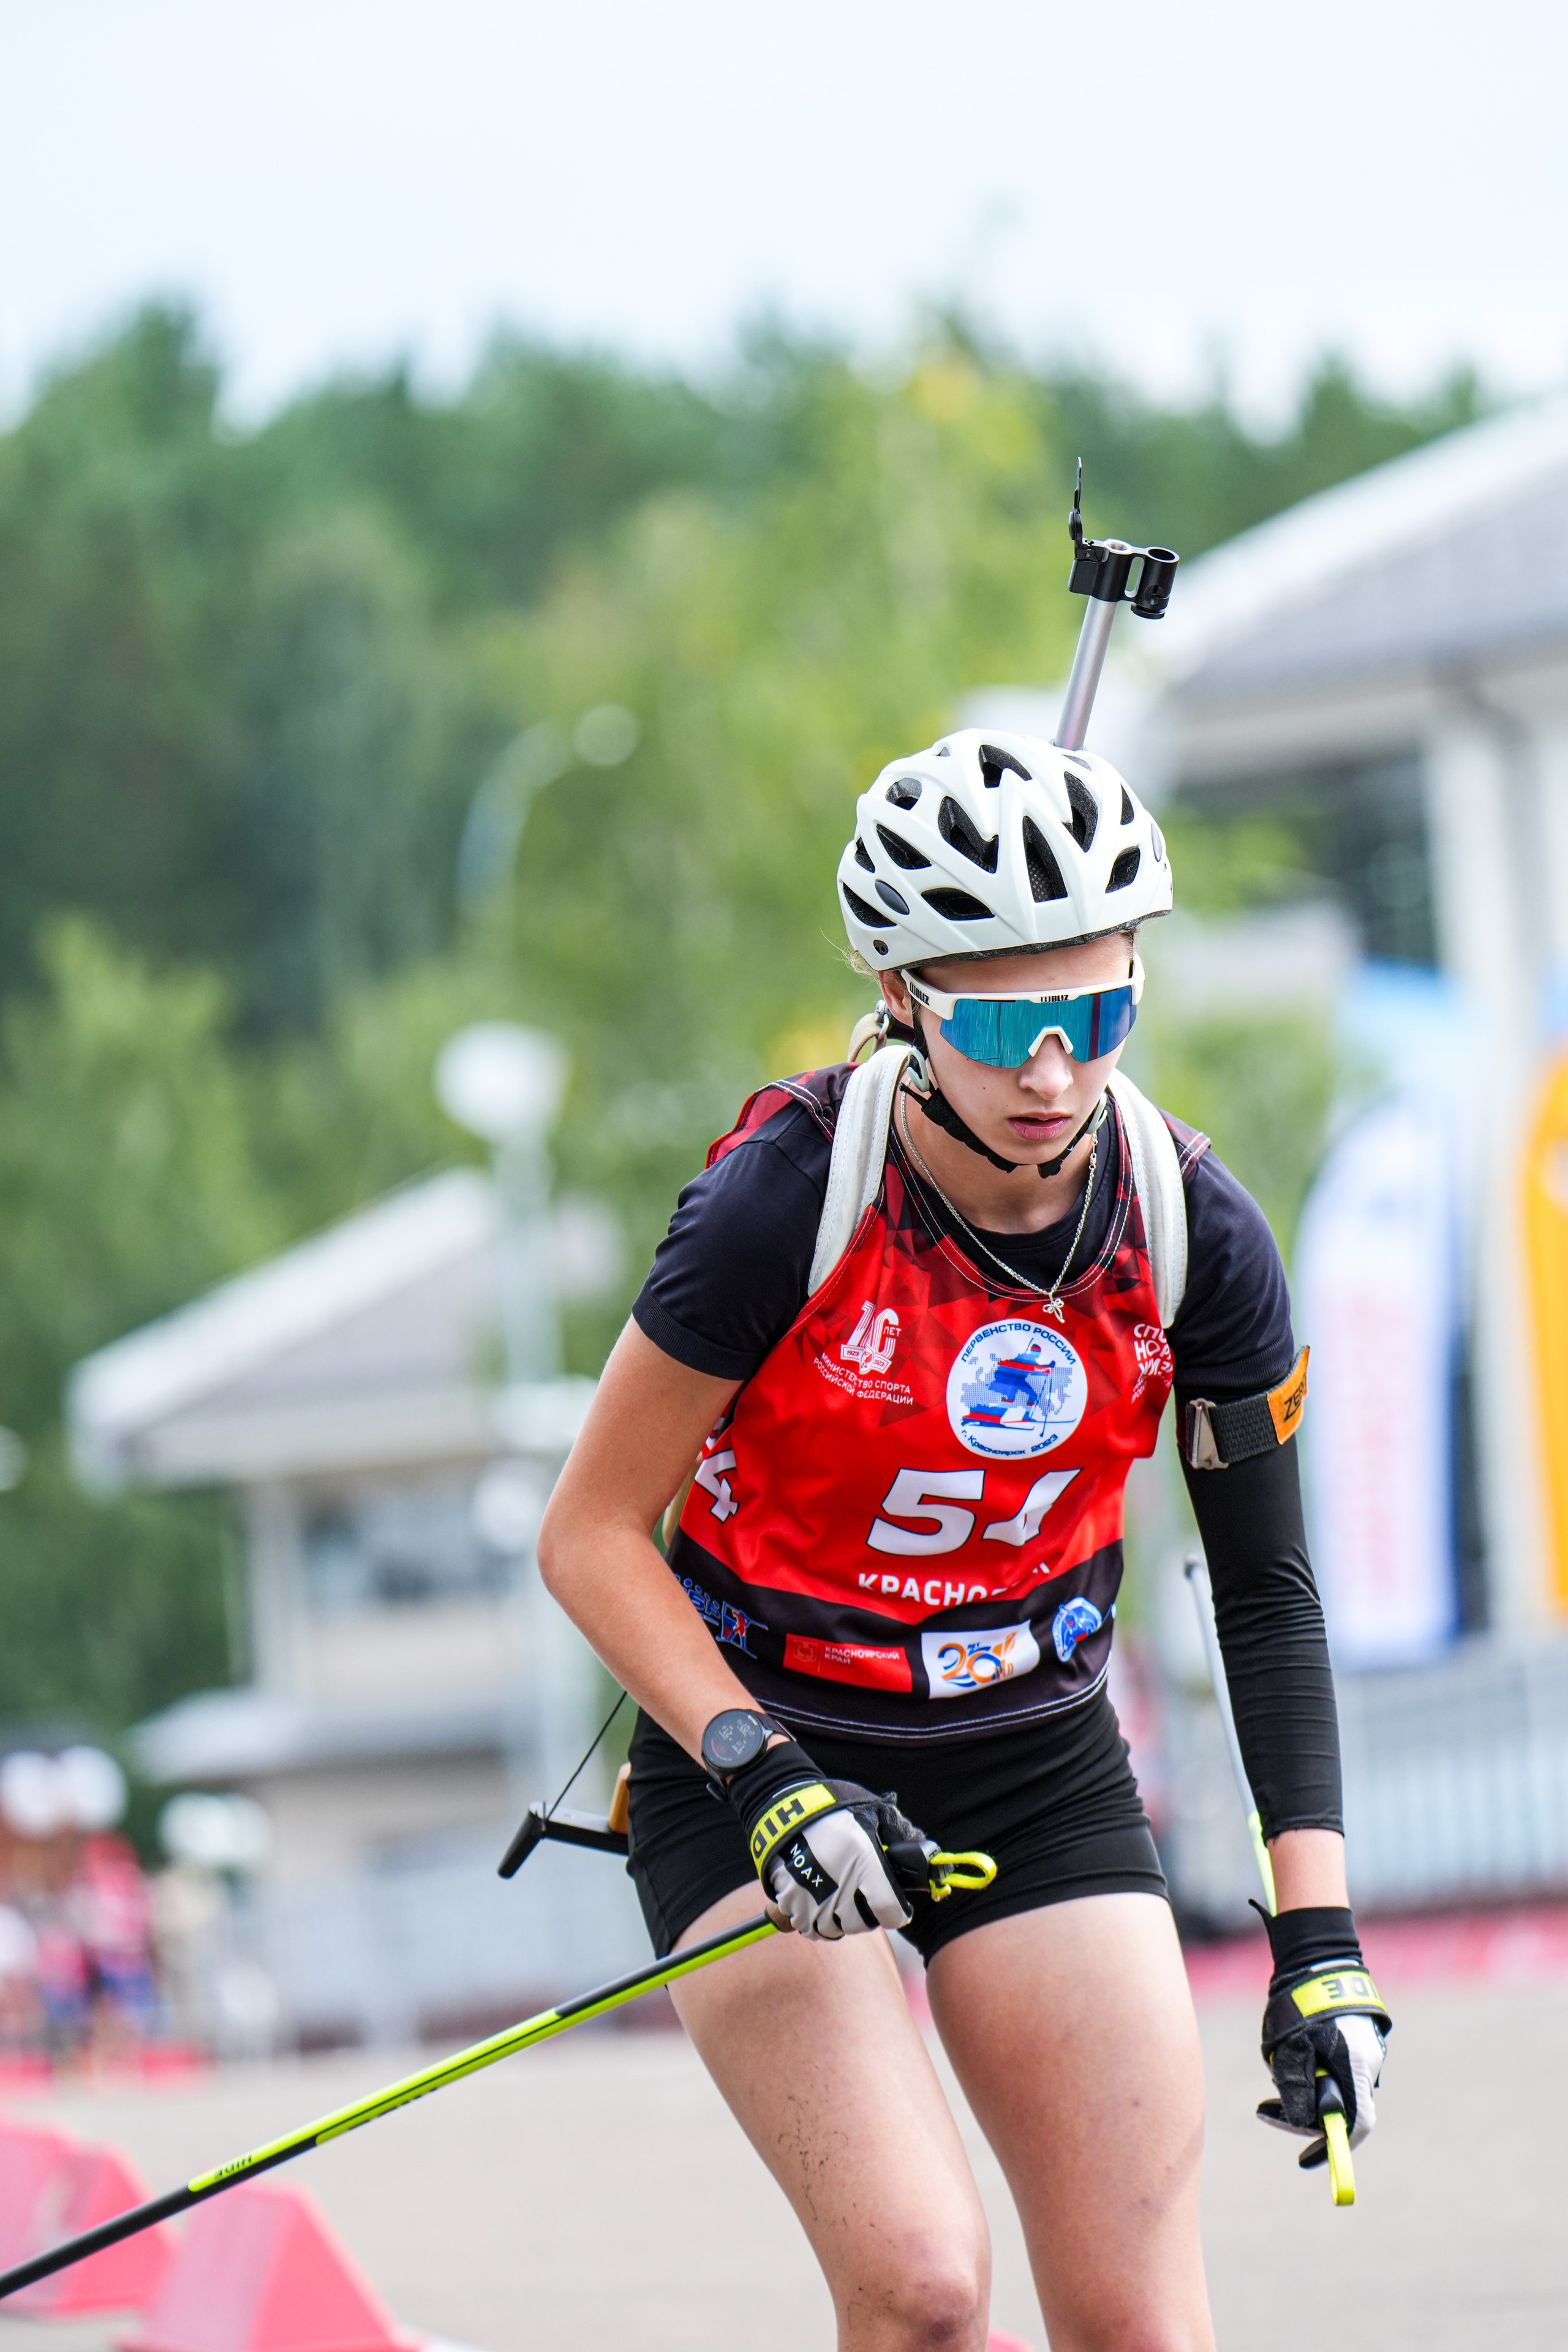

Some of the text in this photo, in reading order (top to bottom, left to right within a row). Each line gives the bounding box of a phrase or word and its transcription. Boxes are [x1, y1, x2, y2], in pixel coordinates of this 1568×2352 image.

[916, 987, 930, 1006] BLIZ
[883, 1326, 901, 1336] ЛЕТ
[1134, 1323, 1167, 1343] СПО
[961, 1323, 1076, 1365] ПЕРВЕНСТВО РОССИИ
[1134, 1340, 1171, 1361] НОР
[813, 1357, 913, 1405] РОССИЙСКОЙ ФЕДЕРАЦИИ
[875, 1379, 910, 1394] СПОРТА
[968, 1435, 1026, 1456] Красноярск
[1031, 1434, 1058, 1452] 2023
[825, 1646, 900, 1660] КРАСНОЯРСКИЙ
[753, 1798, 805, 1860] HID
